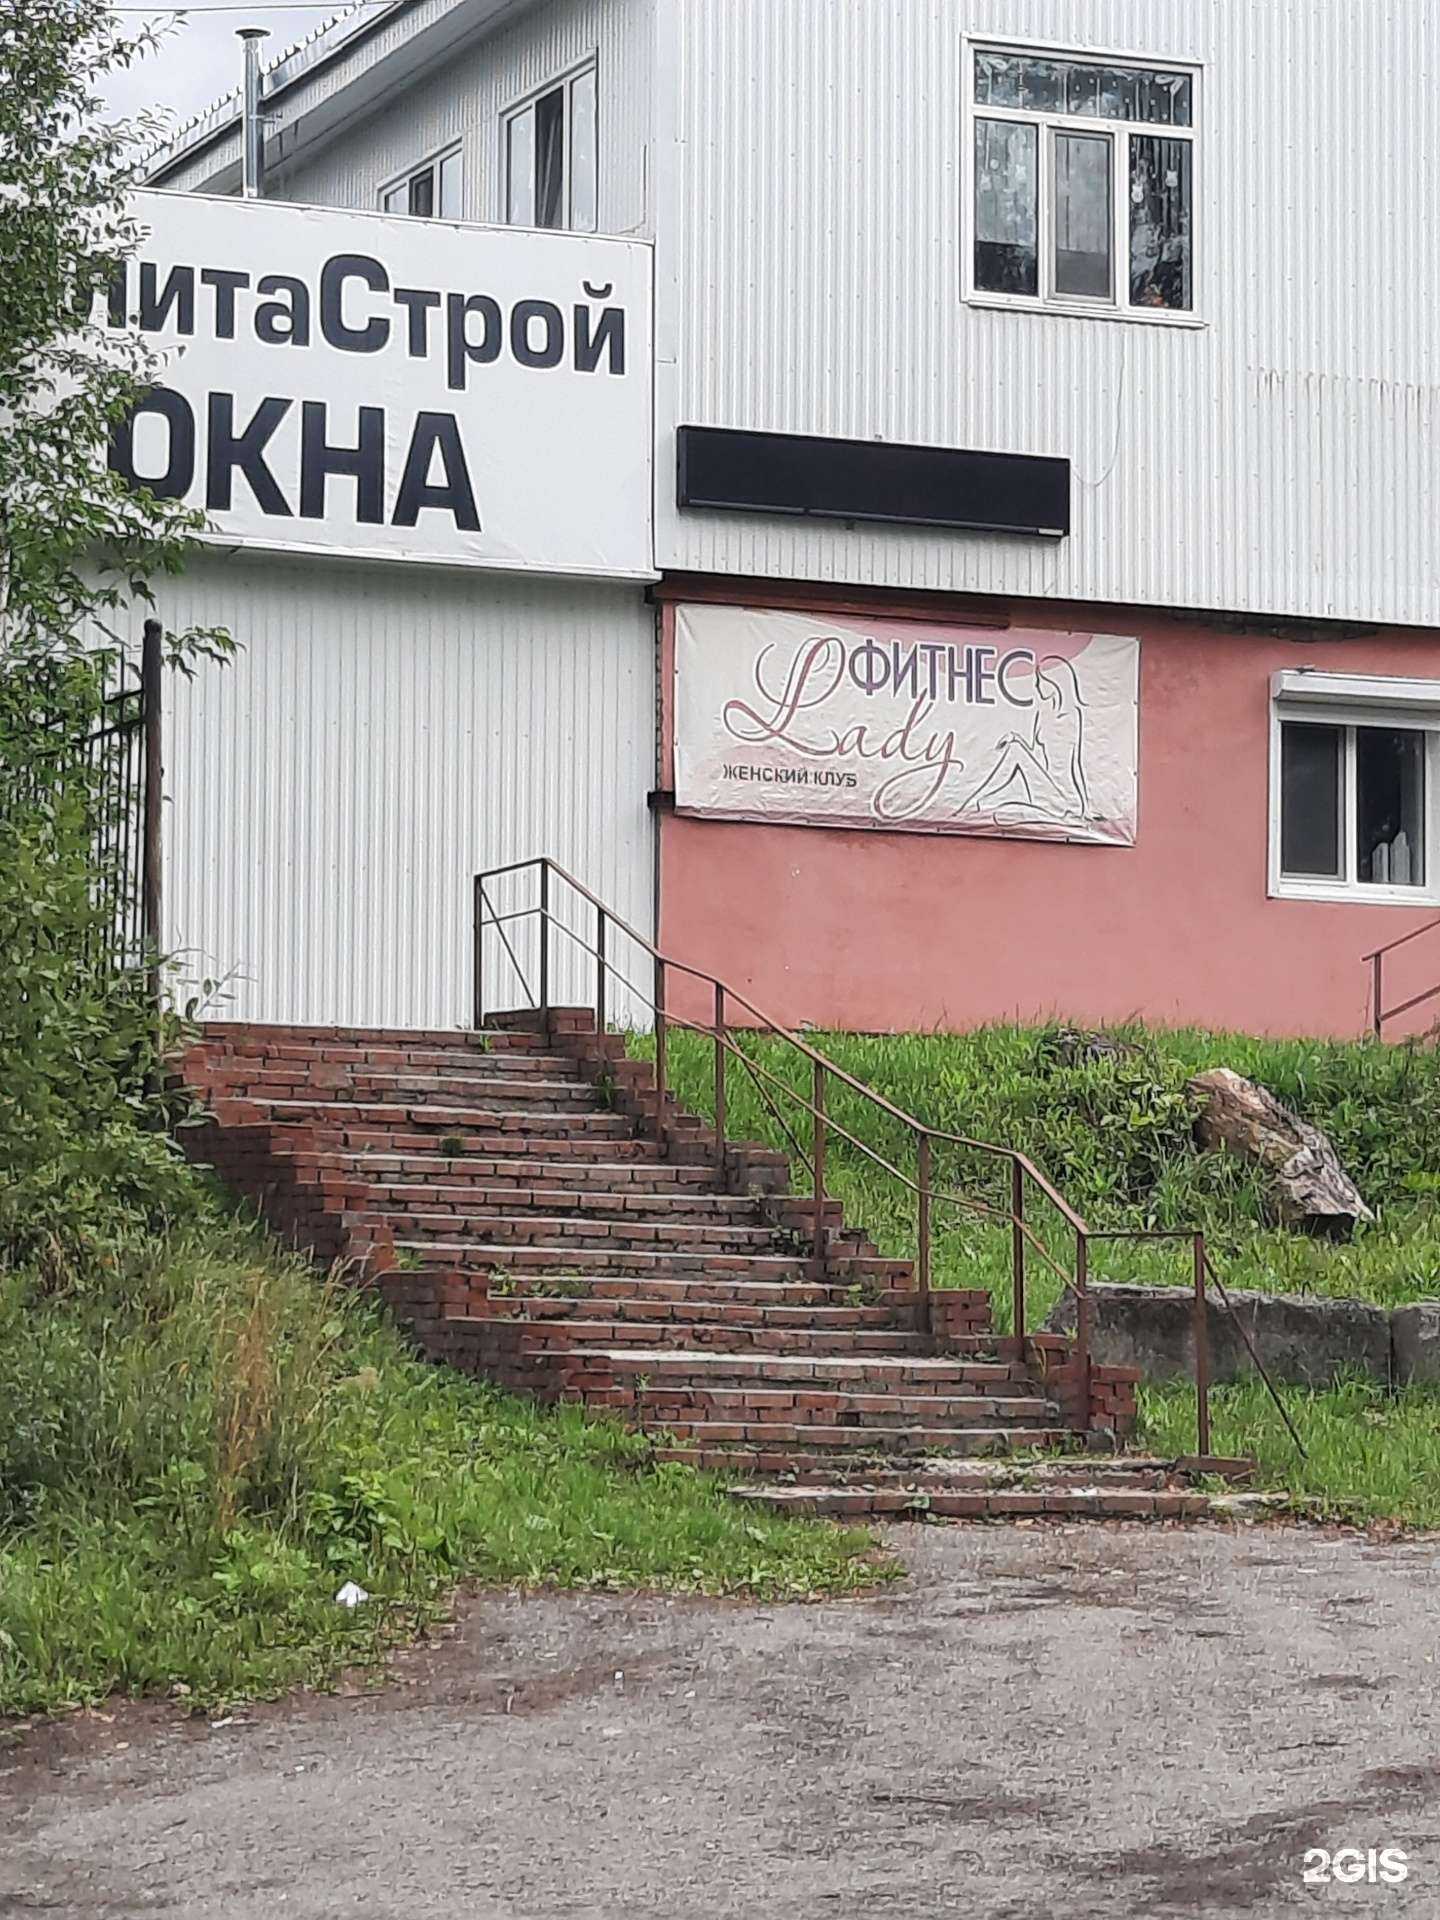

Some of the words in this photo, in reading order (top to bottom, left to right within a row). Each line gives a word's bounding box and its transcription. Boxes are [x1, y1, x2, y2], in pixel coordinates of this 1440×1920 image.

[107, 386, 482, 532] ОКНА
[848, 639, 1035, 706] ФИТНЕС
[722, 763, 808, 785] ЖЕНСКИЙ
[813, 769, 858, 788] КЛУБ
[723, 637, 964, 820] Lady
